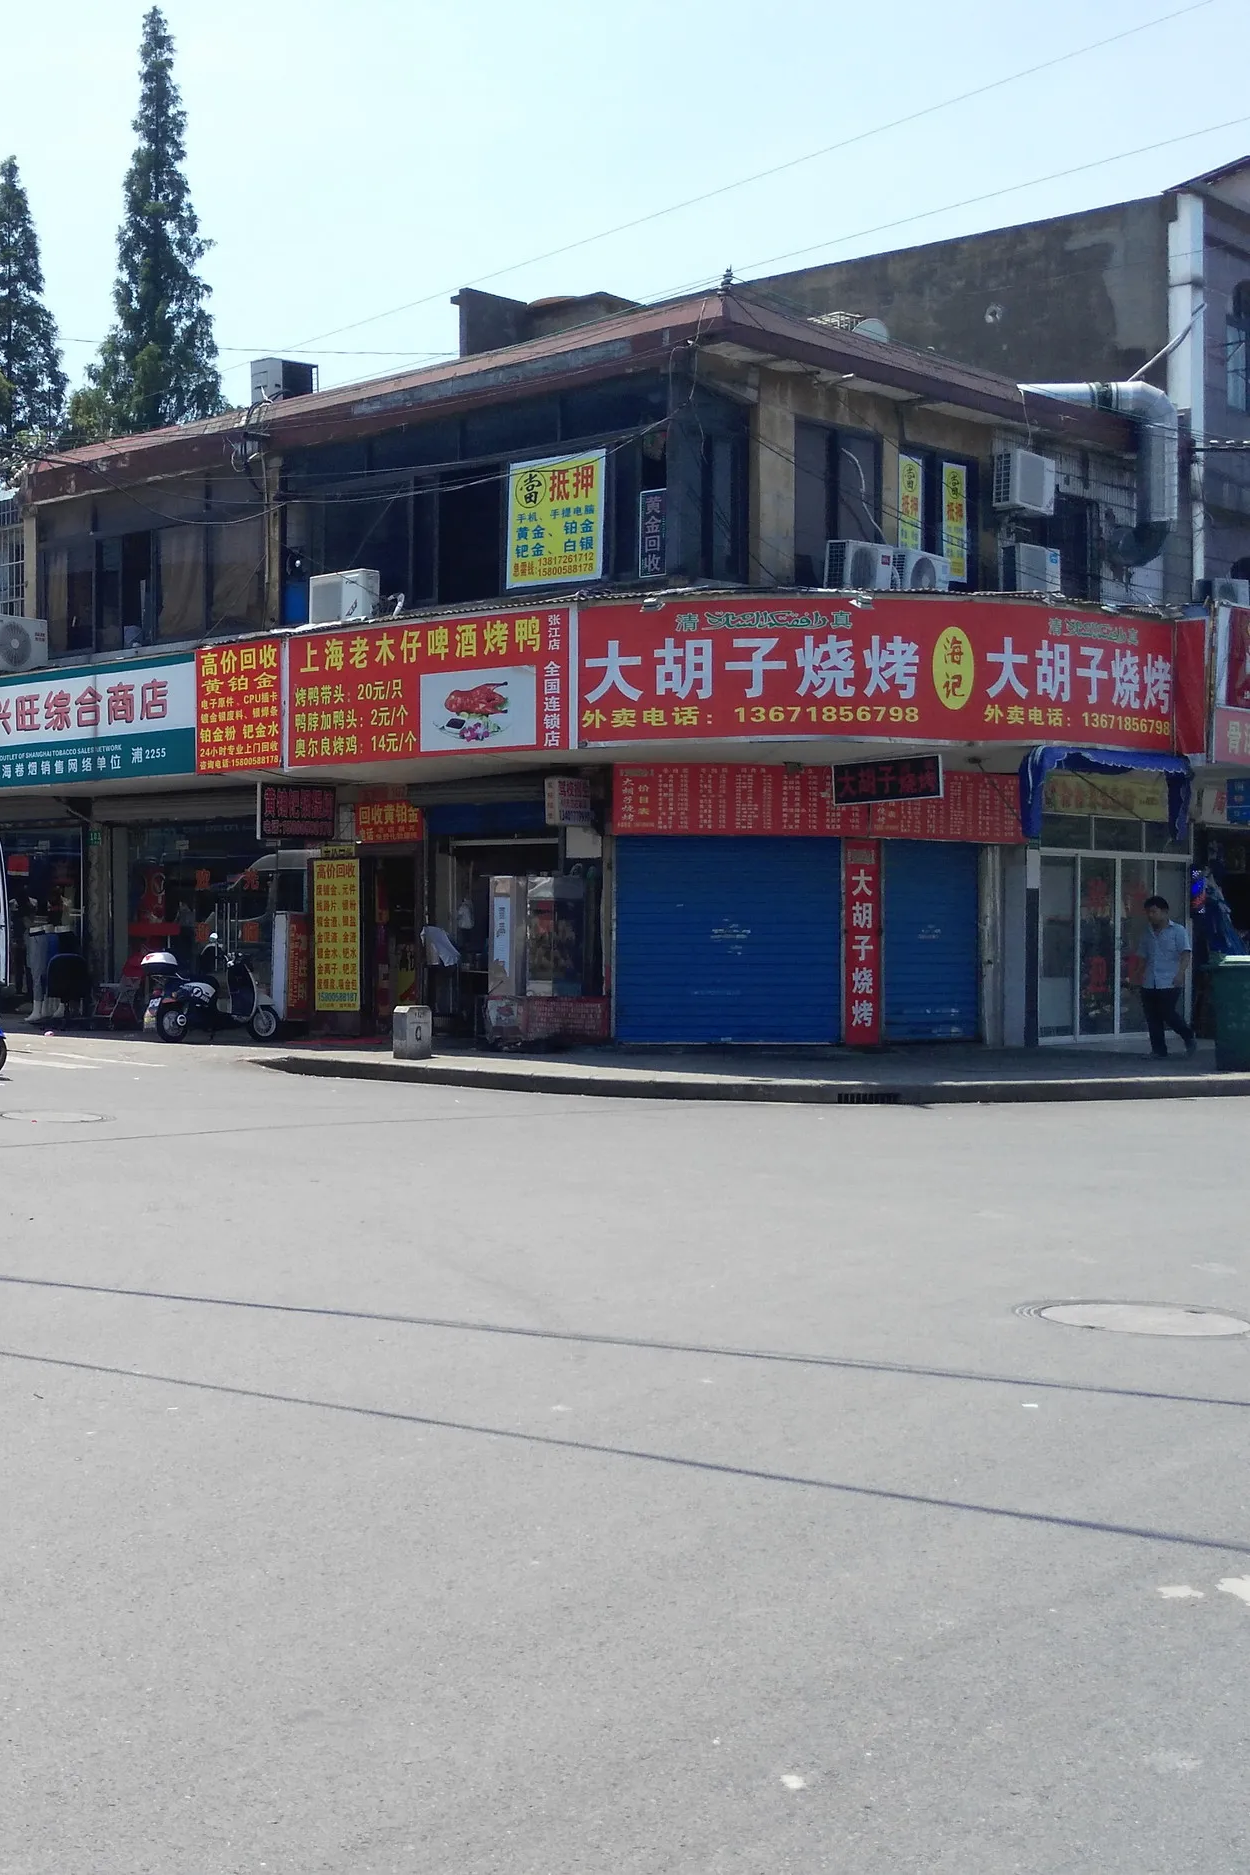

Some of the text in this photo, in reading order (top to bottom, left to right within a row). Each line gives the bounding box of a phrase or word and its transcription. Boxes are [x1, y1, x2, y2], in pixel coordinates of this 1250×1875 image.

[548, 465, 594, 502] 抵押
[538, 552, 594, 567] 13817261712
[538, 563, 594, 577] 15800588178
[548, 614, 561, 651] 张江店
[676, 611, 852, 631] 清 真
[200, 644, 278, 677] 高价回收
[300, 616, 541, 674] 上海老木仔啤酒烤鸭
[584, 635, 920, 703] 大胡子烧烤
[943, 635, 966, 698] 海记
[986, 636, 1172, 715] 大胡子烧烤
[201, 672, 278, 696] 黄铂金
[543, 661, 562, 747] 全国连锁店
[200, 721, 279, 743] 铂金粉 钯金水
[52, 748, 77, 757] TOBACCO
[200, 741, 279, 757] 24小时专业上门回收
[316, 863, 356, 880] 高价回收
[851, 868, 874, 1027] 大胡子烧烤
